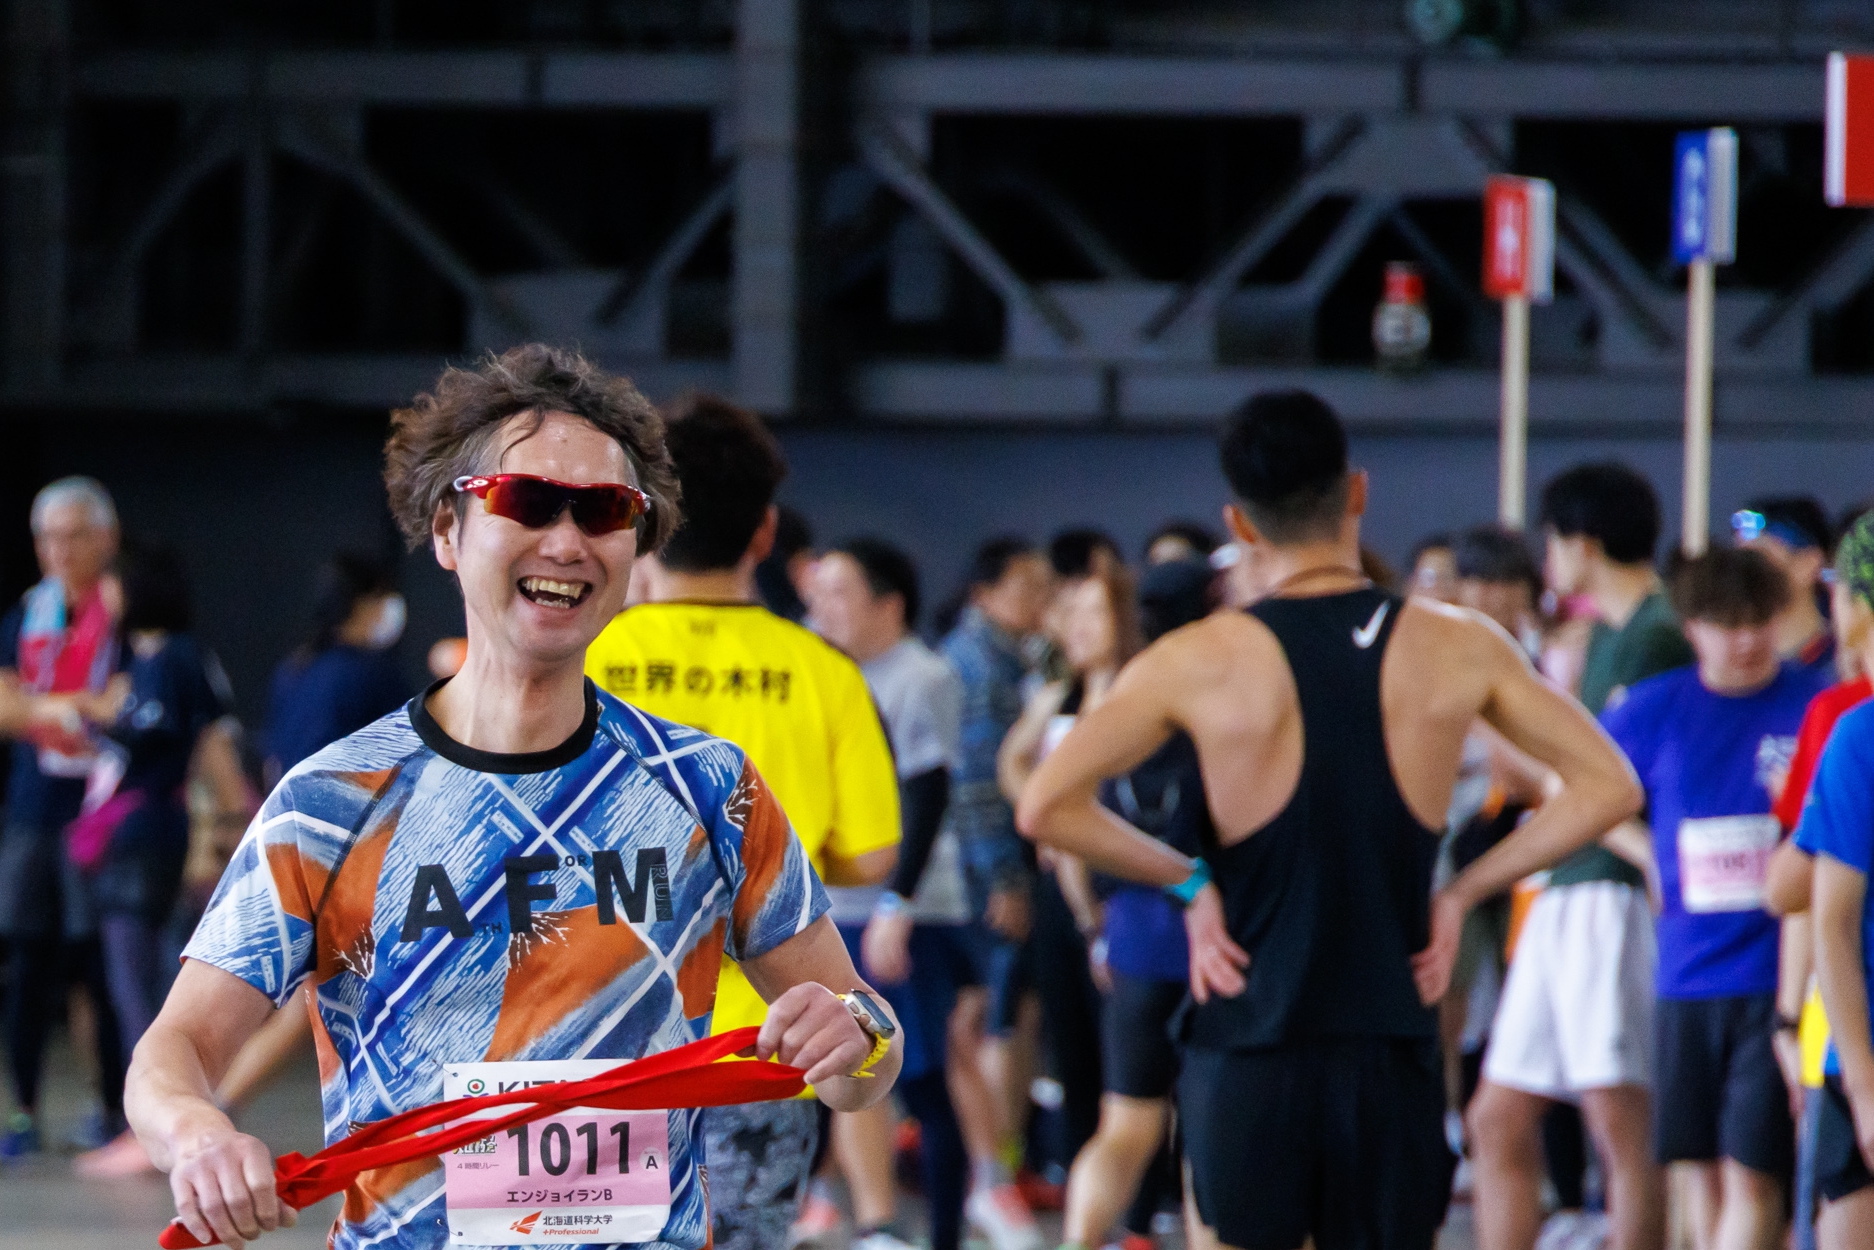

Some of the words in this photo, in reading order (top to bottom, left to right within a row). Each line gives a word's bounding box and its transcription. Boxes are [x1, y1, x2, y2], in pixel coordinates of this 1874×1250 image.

[604, 660, 792, 704] 世界の木村
[506, 1121, 630, 1176] 1011
[645, 1155, 659, 1170] A
[506, 1188, 613, 1203] エンジョイランB
[542, 1214, 613, 1226] 北海道科学大学
